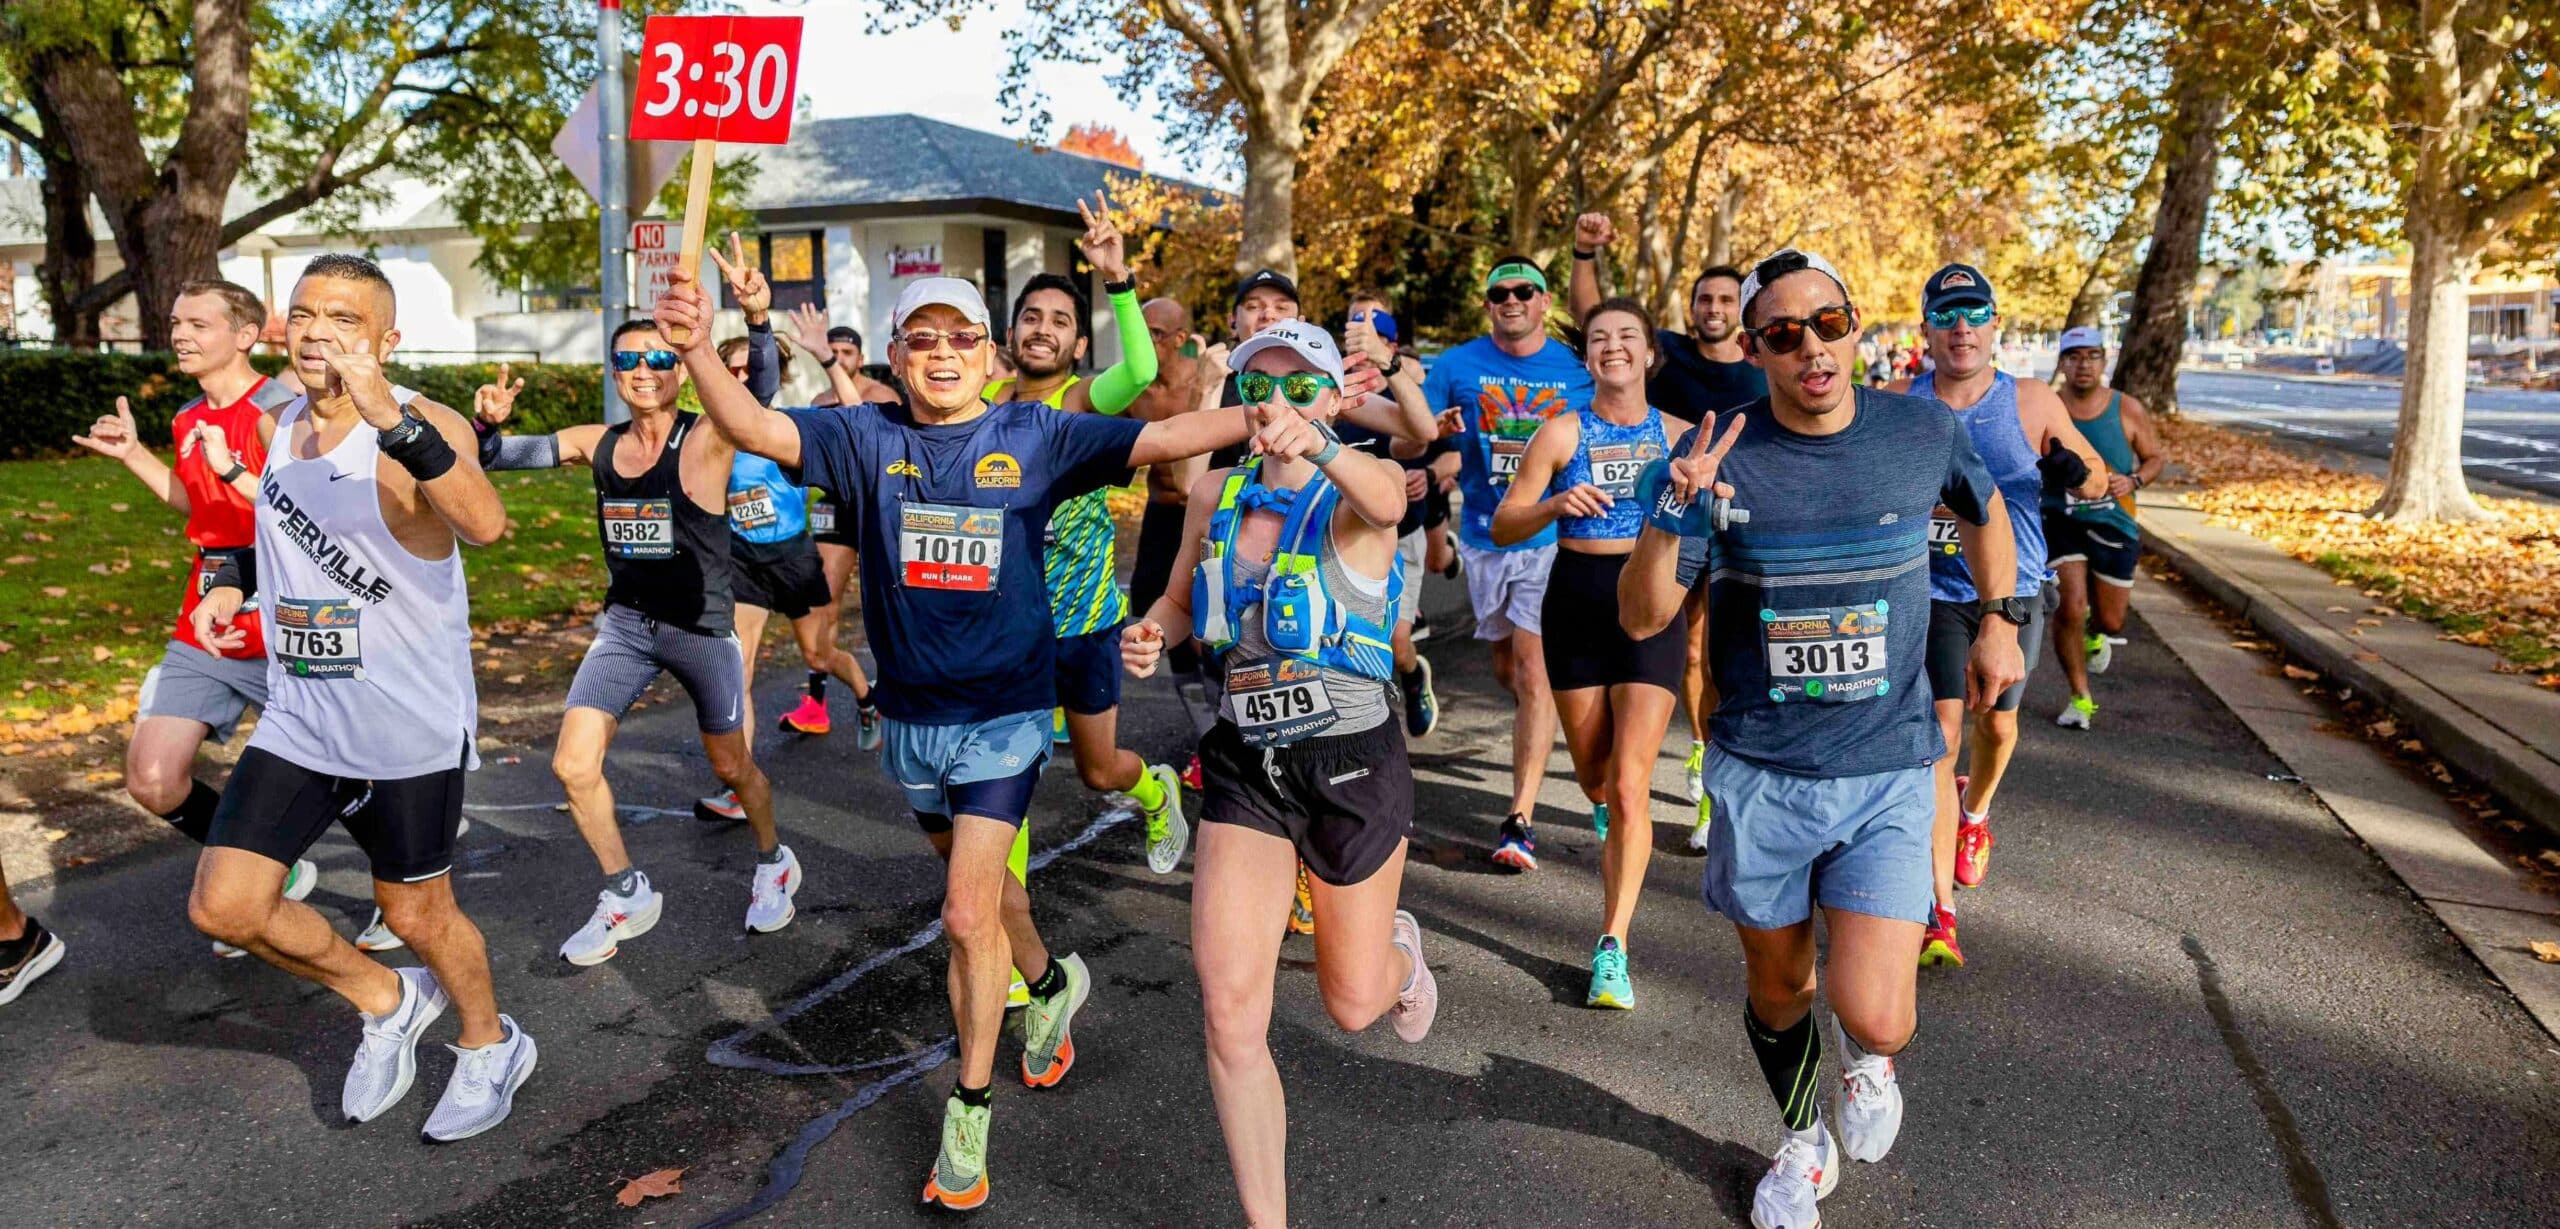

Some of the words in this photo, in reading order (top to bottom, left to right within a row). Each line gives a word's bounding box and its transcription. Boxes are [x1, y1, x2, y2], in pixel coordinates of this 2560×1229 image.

[644, 41, 788, 120] 3:30
[639, 225, 663, 248] NO
[637, 252, 680, 265] PARKIN
[650, 272, 667, 284] AN
[1479, 375, 1505, 385] RUN
[735, 501, 767, 519] 2262
[903, 513, 956, 526] CALIFORNIA
[261, 464, 393, 600] NAPERVILLE
[612, 522, 661, 541] 9582
[915, 536, 986, 566] 1010
[278, 520, 321, 566] RUNNING
[321, 564, 384, 606] COMPANY
[922, 572, 938, 581] RUN
[1767, 620, 1831, 631] CALIFORNIA
[282, 628, 343, 656] 7763
[1785, 641, 1869, 675] 3013
[308, 663, 360, 673] MARATHON
[1230, 670, 1271, 684] CALIFORNIA
[1828, 675, 1885, 692] MARATHON
[1246, 687, 1314, 722] 4579
[1281, 714, 1336, 736] MARATHON
